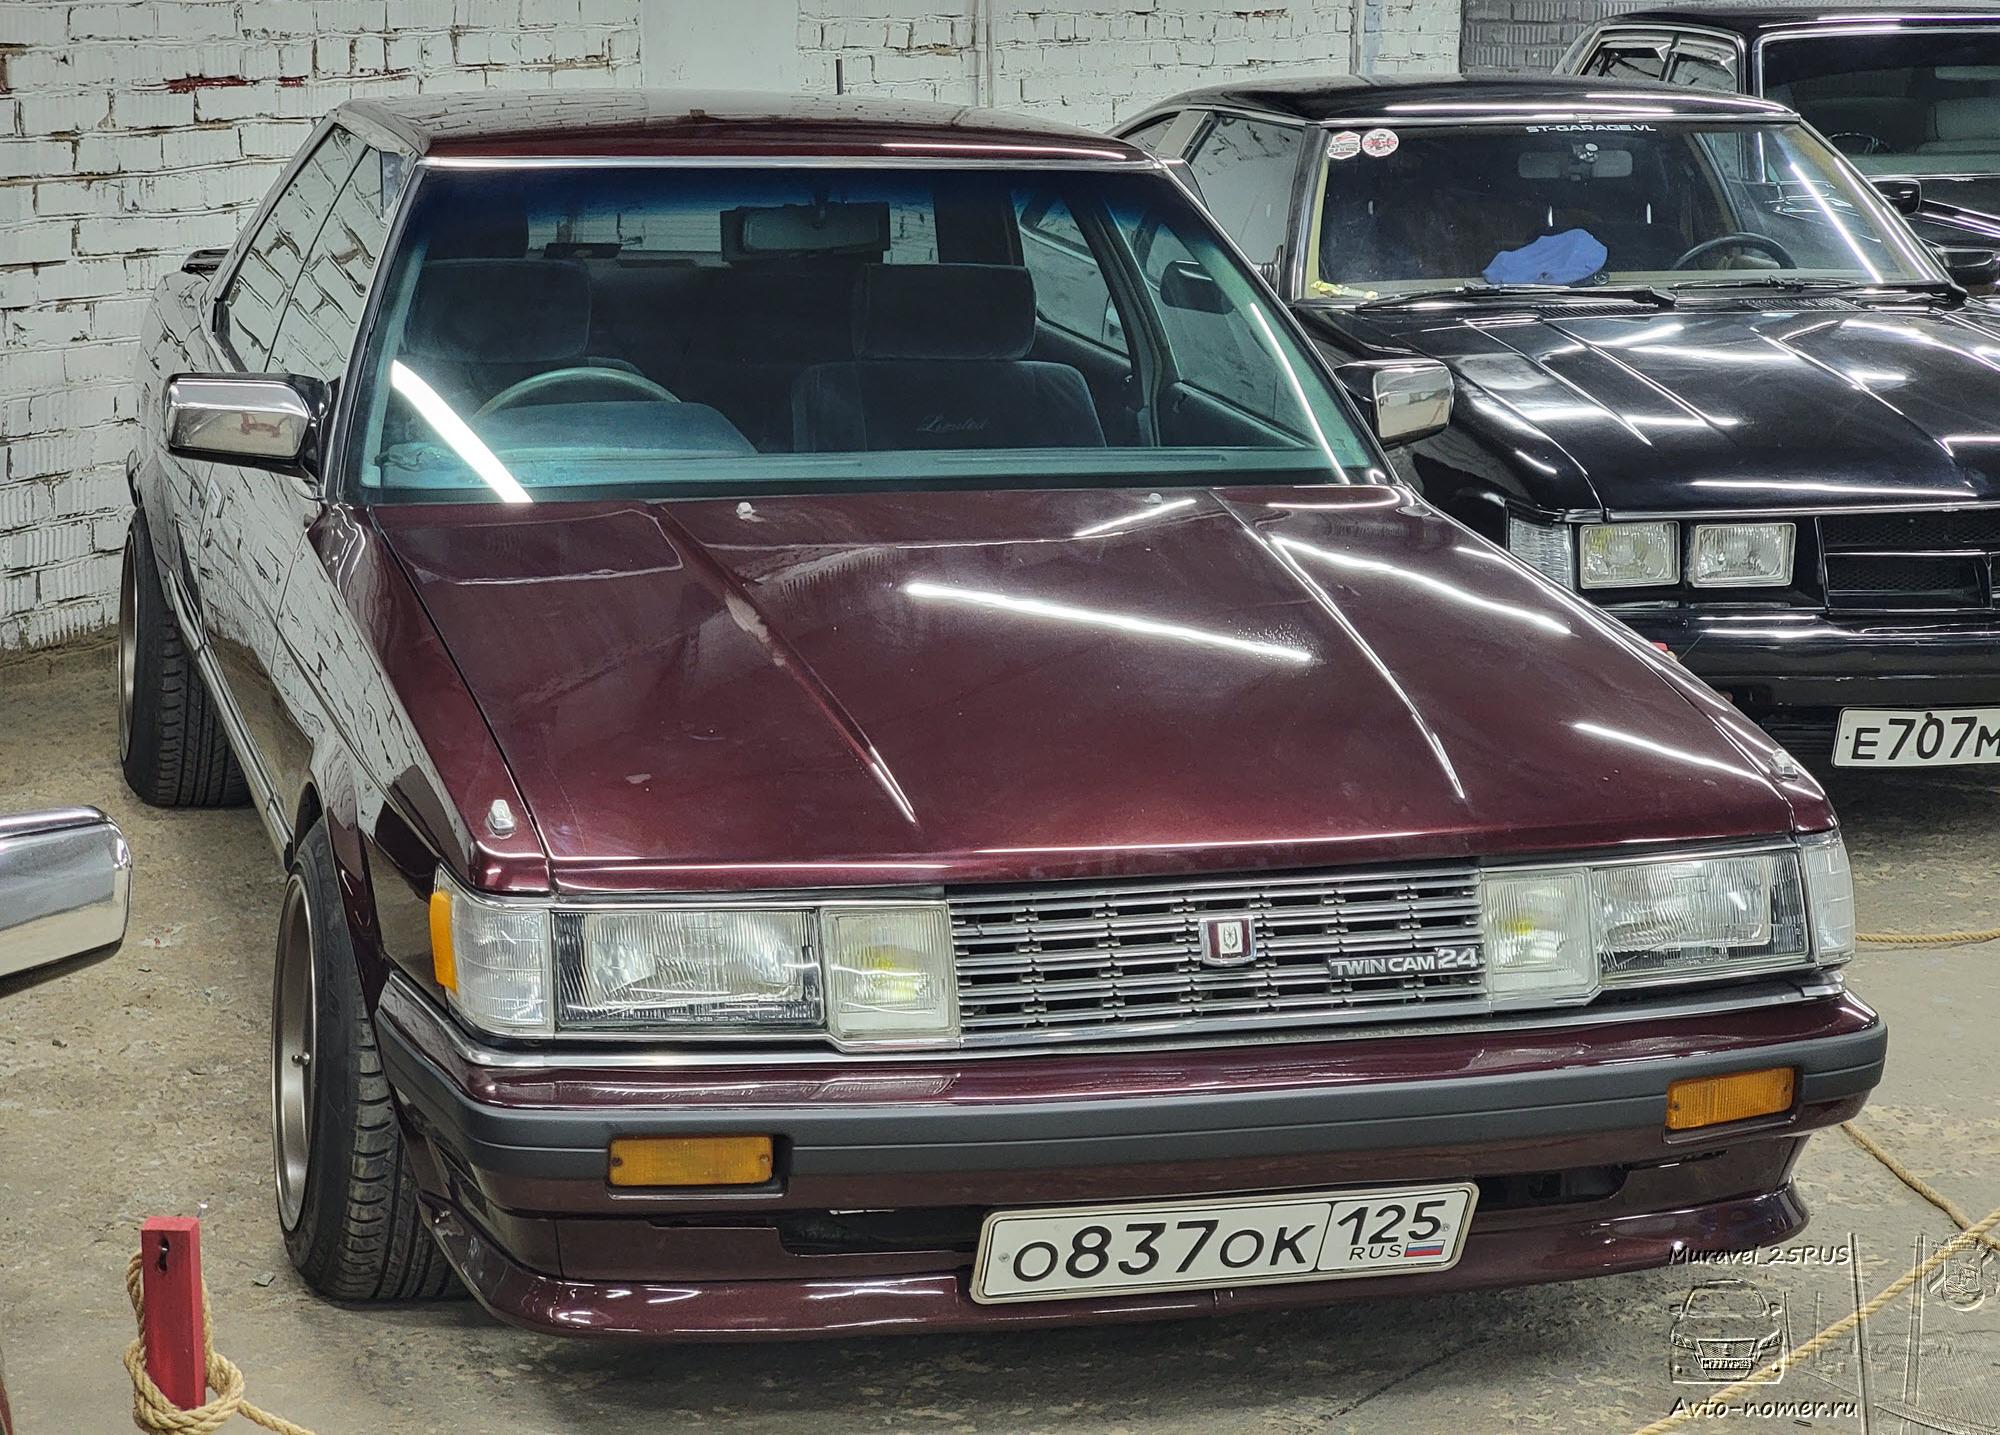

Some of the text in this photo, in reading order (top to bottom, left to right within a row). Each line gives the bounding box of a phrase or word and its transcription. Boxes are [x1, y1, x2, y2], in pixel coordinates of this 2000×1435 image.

[1526, 125, 1657, 133] ST-GARAGE.VL
[1851, 716, 2000, 761] E707M
[1331, 947, 1479, 976] TWIN CAM 24
[1337, 1200, 1446, 1246] 125
[1349, 1244, 1402, 1261] RUS
